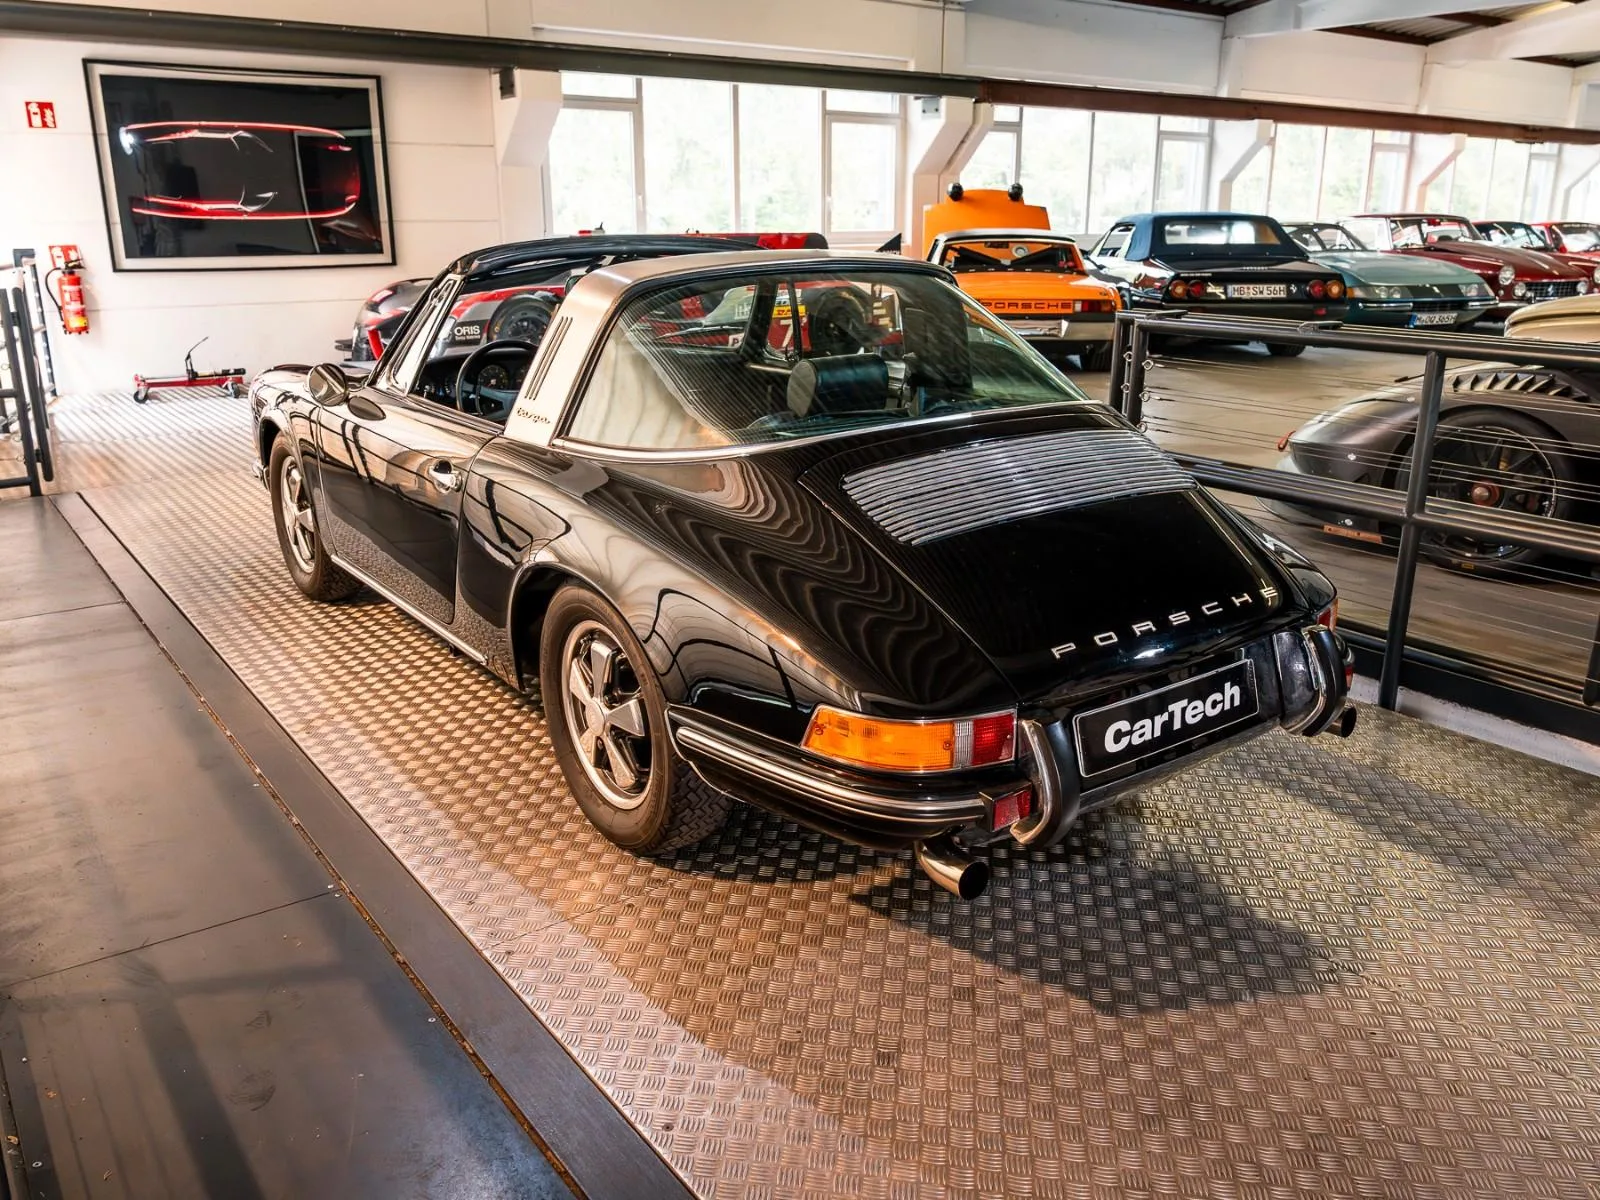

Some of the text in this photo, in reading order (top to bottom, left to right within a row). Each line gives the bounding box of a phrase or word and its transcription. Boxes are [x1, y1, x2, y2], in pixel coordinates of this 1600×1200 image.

[1251, 286, 1265, 296] SW
[1266, 286, 1286, 296] 56H
[982, 302, 1072, 310] PORSCHE
[454, 325, 480, 336] ORIS
[1051, 586, 1278, 659] PORSCHE
[1104, 682, 1241, 753] CarTech
